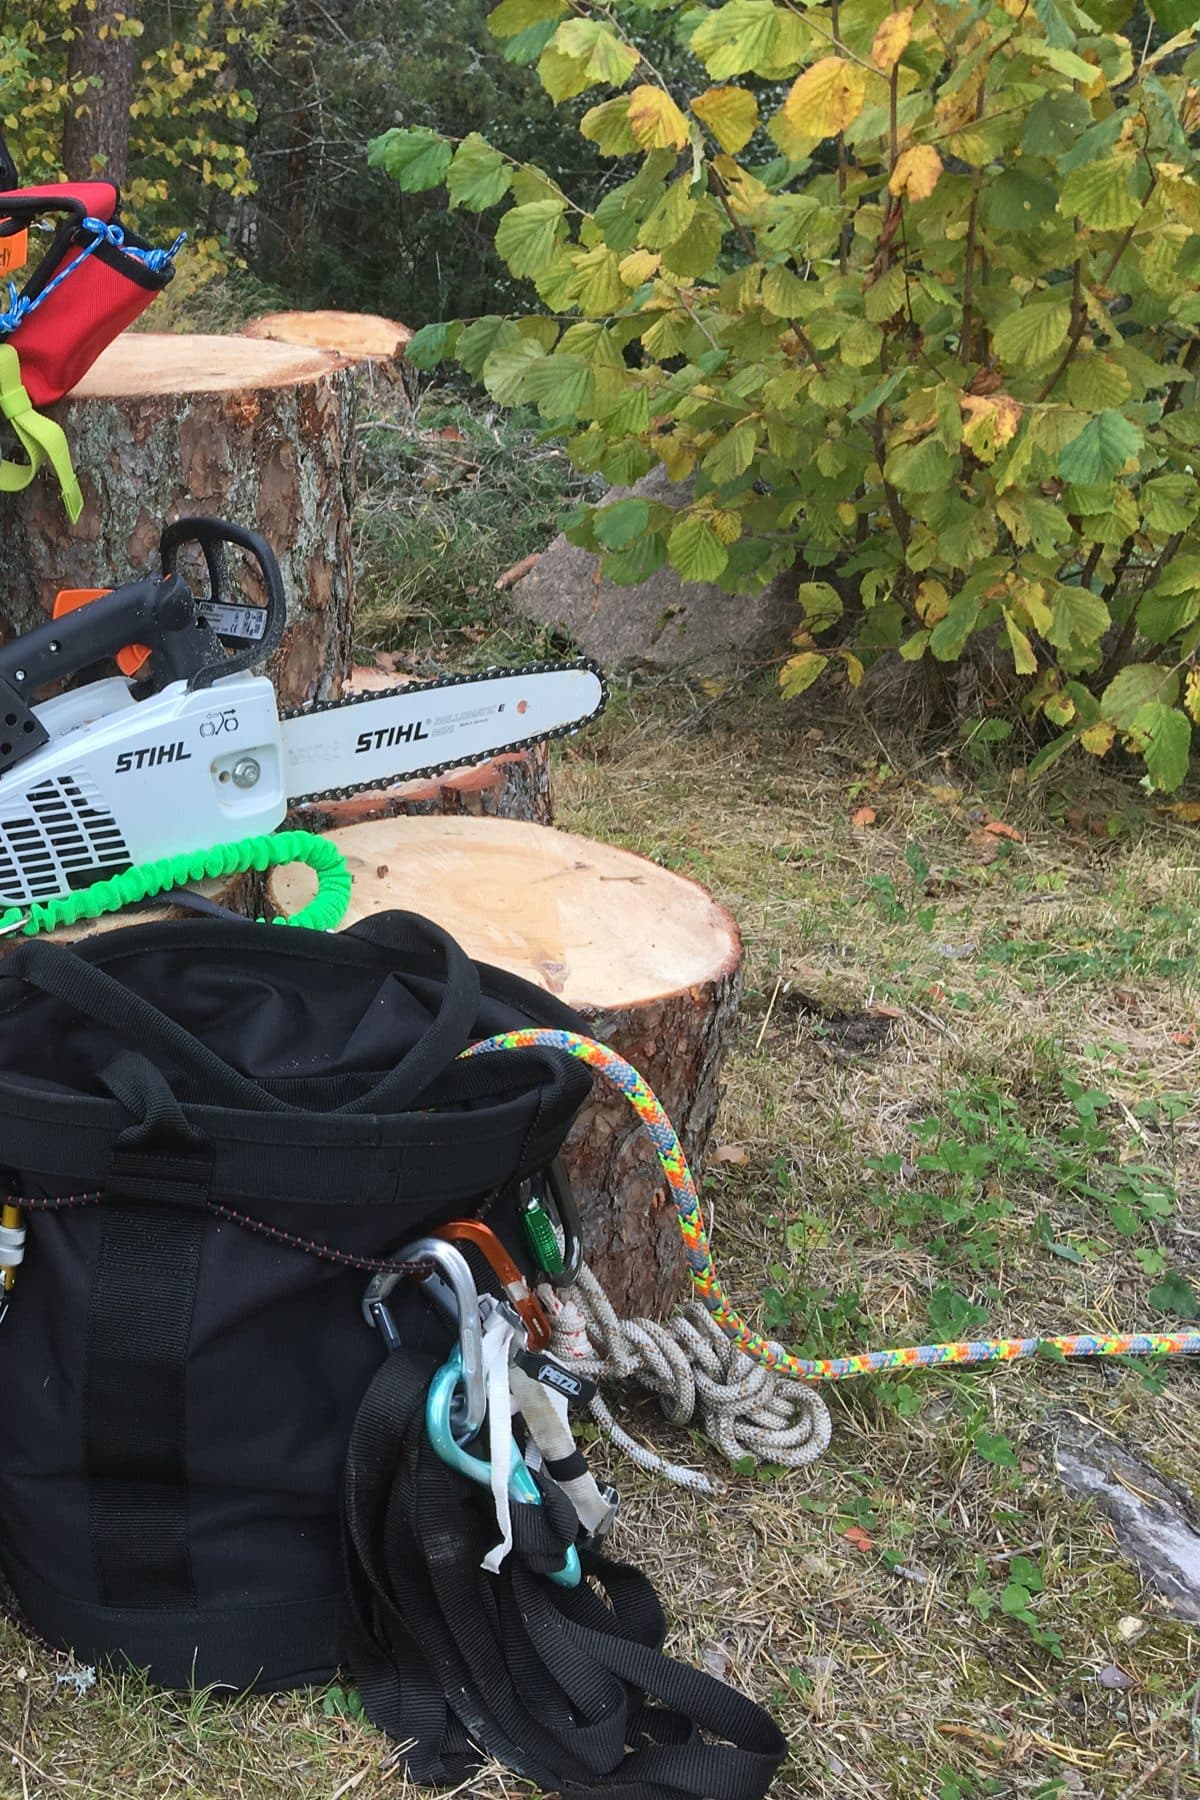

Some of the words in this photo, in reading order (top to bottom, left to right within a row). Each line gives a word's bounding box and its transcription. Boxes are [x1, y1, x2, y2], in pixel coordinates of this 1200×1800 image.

[355, 721, 428, 753] STIHL
[115, 741, 192, 774] STIHL
[538, 1364, 579, 1396] PETZL
